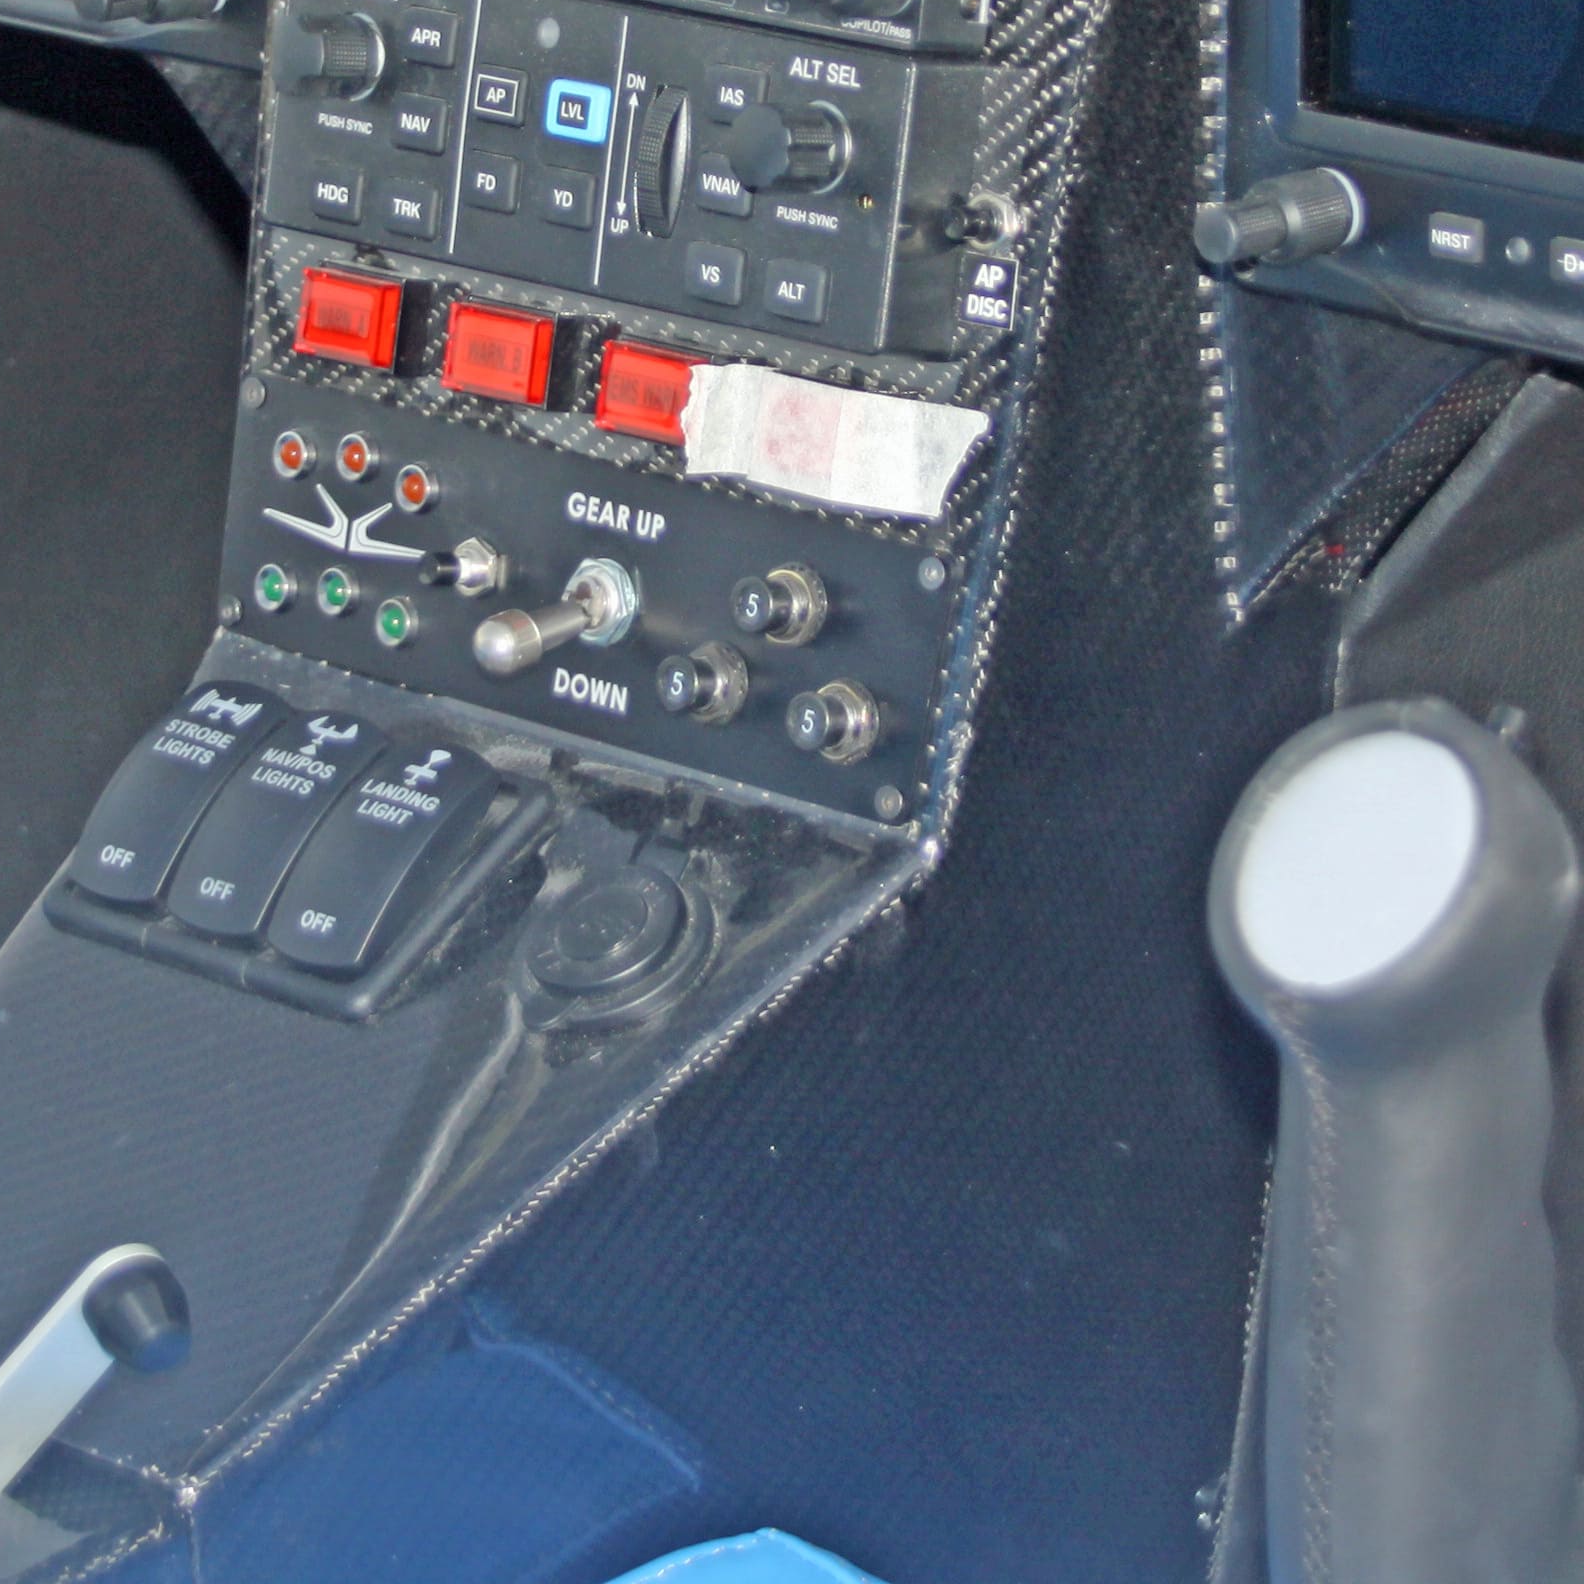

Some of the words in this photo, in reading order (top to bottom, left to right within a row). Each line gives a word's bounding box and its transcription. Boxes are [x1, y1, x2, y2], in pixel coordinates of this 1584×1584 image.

[411, 27, 442, 48] APR
[625, 73, 647, 91] DN
[789, 56, 823, 80] ALT
[826, 62, 862, 89] SEL
[486, 87, 506, 104] AP
[719, 86, 745, 107] IAS
[560, 101, 585, 121] LVL
[318, 112, 346, 131] PUSH
[346, 115, 374, 135] SYNC
[400, 113, 431, 134] NAV
[317, 182, 349, 204] HDG
[476, 172, 497, 191] FD
[702, 173, 741, 197] VNAV
[393, 198, 422, 219] TRK
[553, 188, 574, 208] YD
[609, 217, 629, 234] UP
[776, 204, 806, 223] PUSH
[807, 211, 839, 230] SYNC
[1431, 228, 1471, 251] NRST
[701, 263, 721, 283] VS
[973, 262, 1004, 290] AP
[778, 280, 806, 301] ALT
[967, 293, 1009, 320] DISC
[567, 491, 631, 532] GEAR
[636, 508, 666, 540] UP
[744, 592, 760, 618] 5
[553, 667, 629, 713] DOWN
[669, 670, 684, 696] 5
[800, 709, 815, 734] 5
[165, 718, 236, 750] STROBE
[152, 736, 216, 765] LIGHTS
[261, 746, 337, 780] NAV/POS
[250, 766, 315, 796] LIGHTS
[359, 778, 441, 813] LANDING
[356, 798, 414, 826] LIGHT
[100, 844, 137, 868] OFF
[199, 876, 236, 901] OFF
[299, 908, 337, 934] OFF
